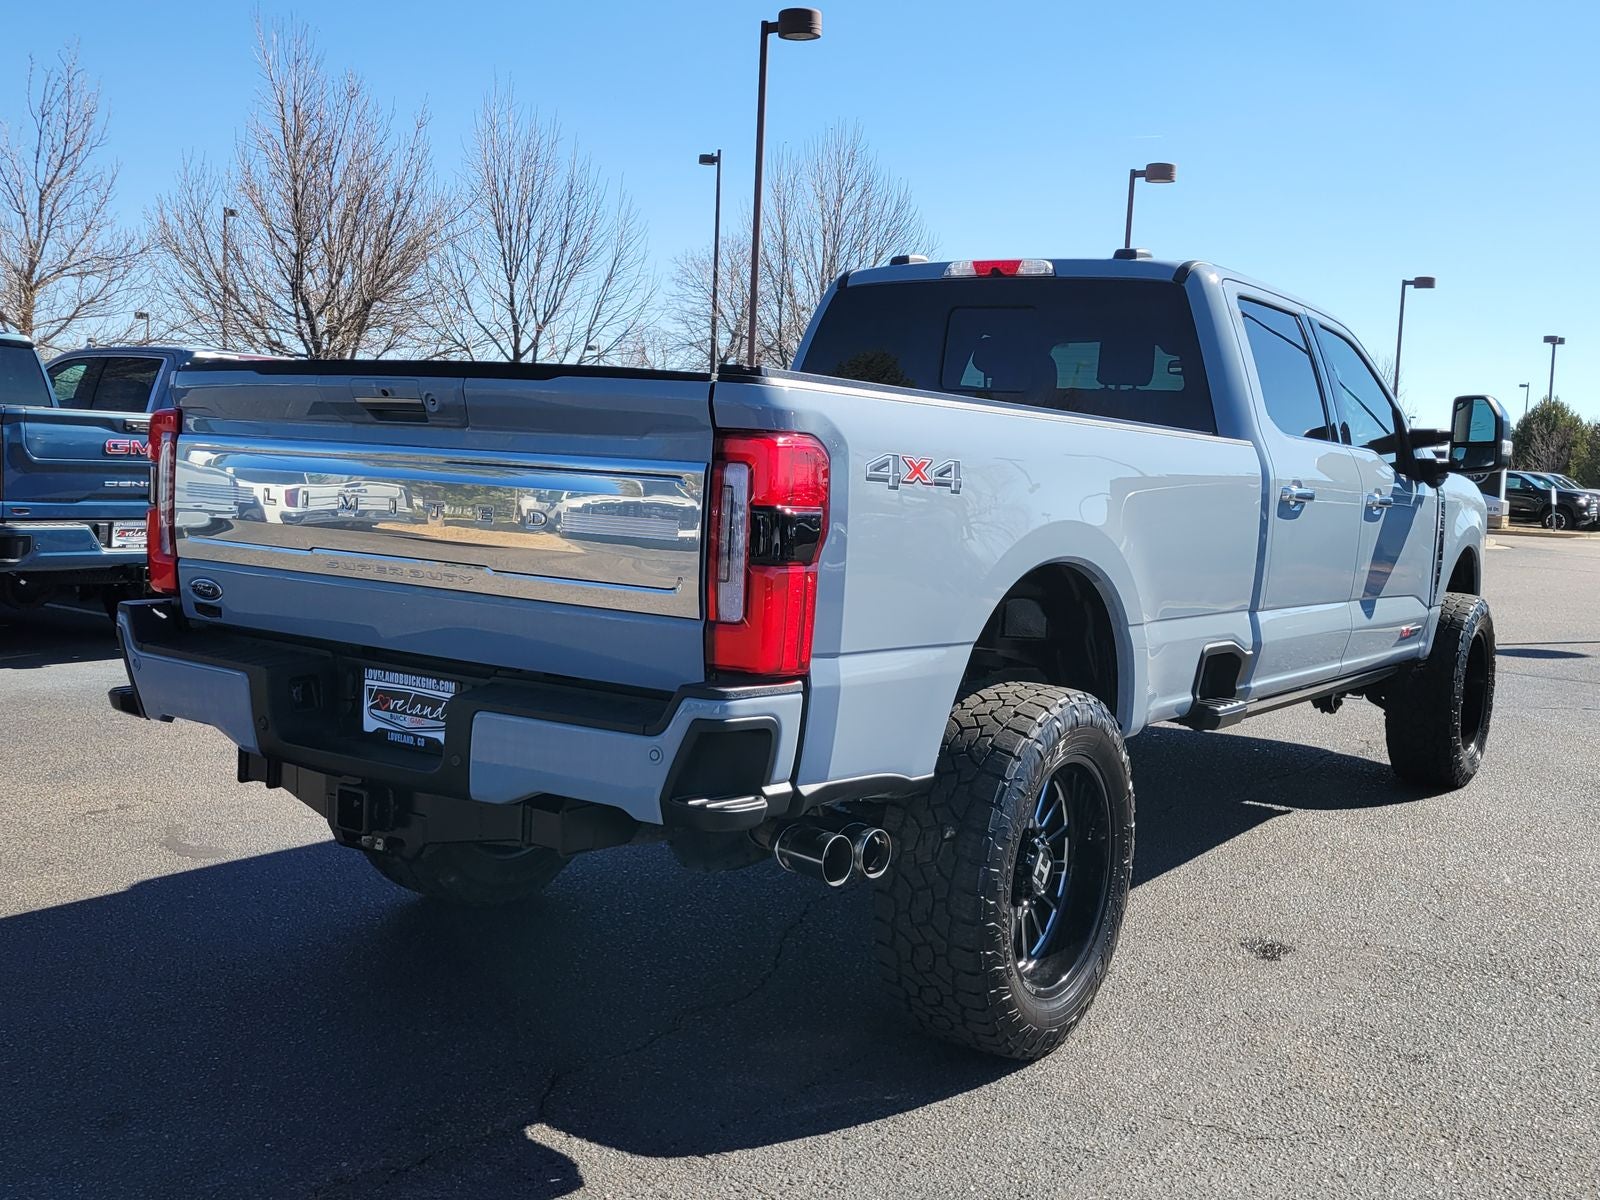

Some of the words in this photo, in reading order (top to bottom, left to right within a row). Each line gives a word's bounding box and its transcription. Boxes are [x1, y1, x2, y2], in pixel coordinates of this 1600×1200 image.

[105, 438, 150, 455] GM
[263, 487, 547, 530] LIMITED
[326, 560, 404, 578] SUPER
[408, 568, 475, 585] DUTY
[389, 713, 408, 722] BUICK
[410, 717, 425, 726] GMC
